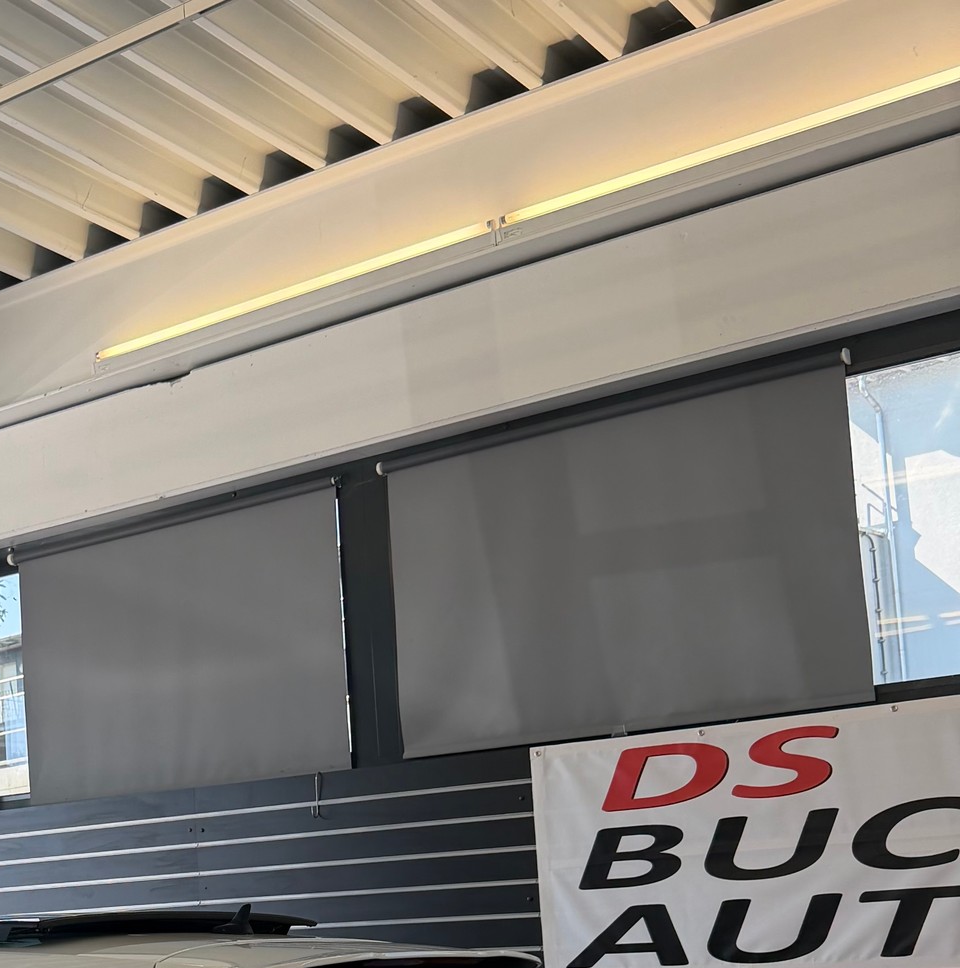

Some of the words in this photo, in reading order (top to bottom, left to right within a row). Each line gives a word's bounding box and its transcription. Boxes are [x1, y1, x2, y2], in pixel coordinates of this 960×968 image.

[601, 725, 839, 812] DS
[579, 796, 960, 890] BUC
[566, 886, 960, 968] AUT
